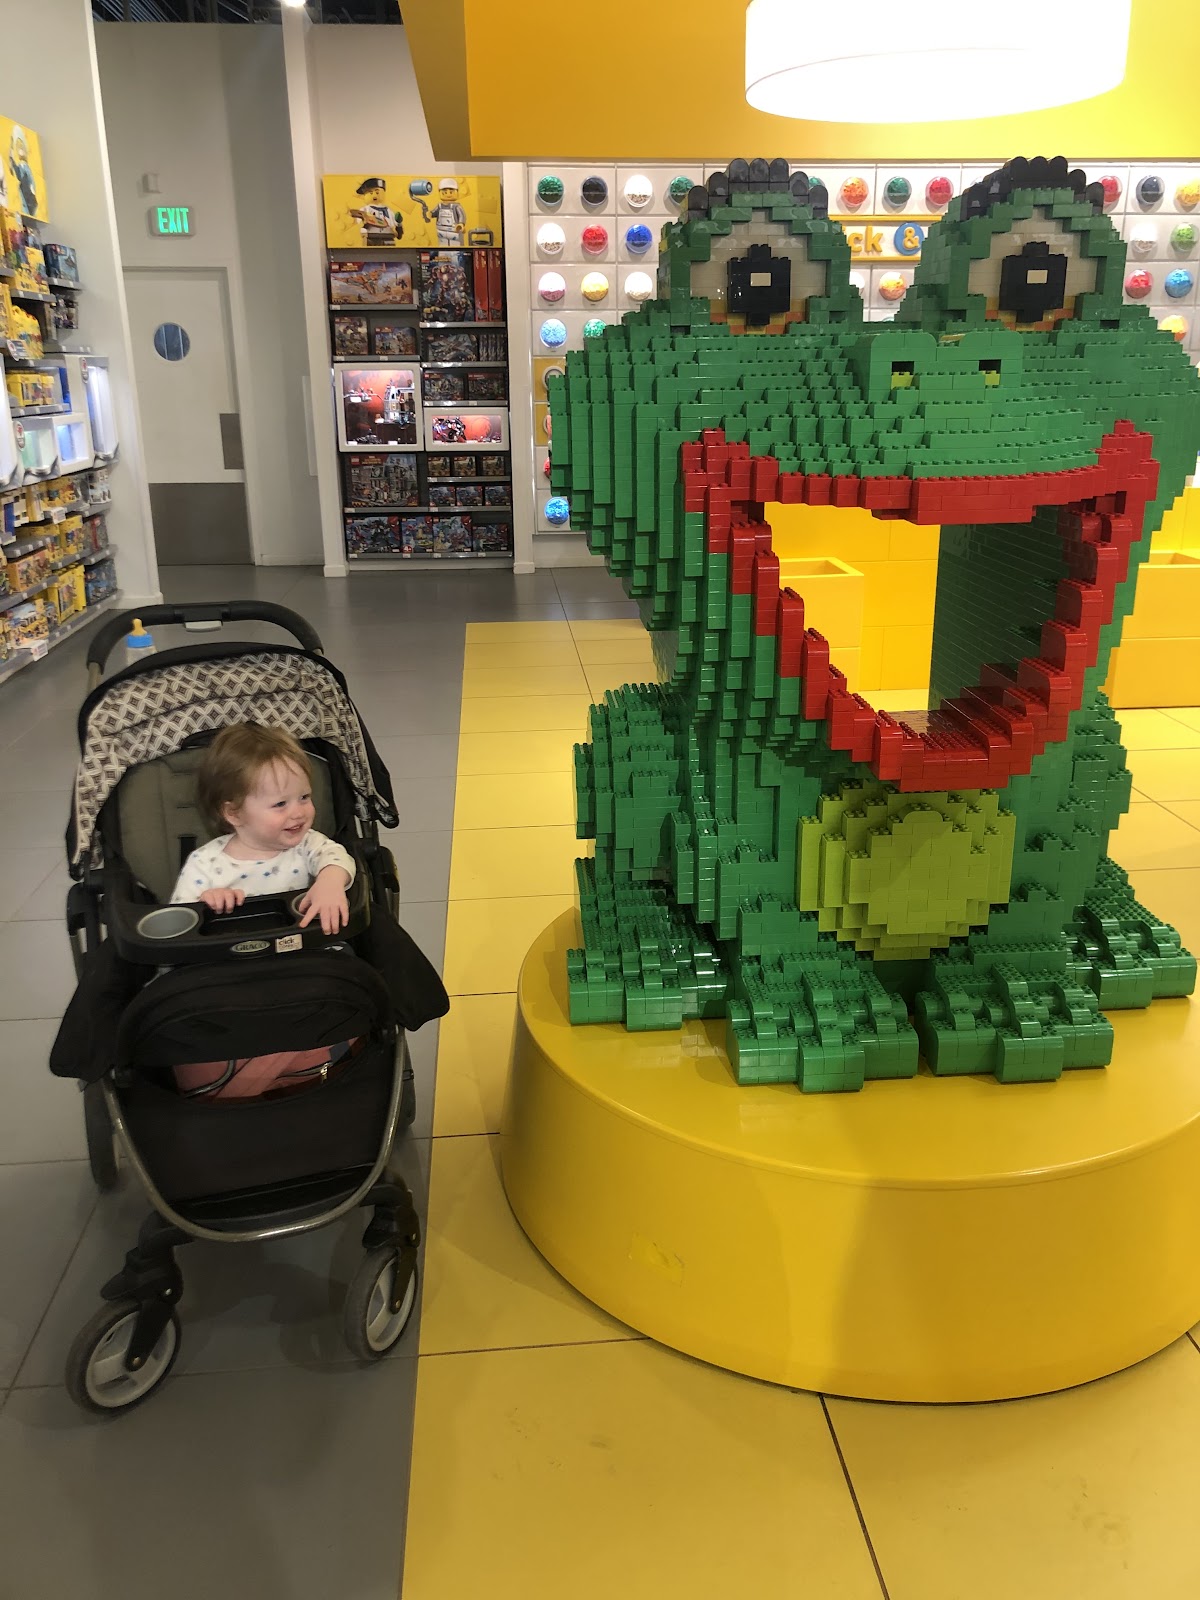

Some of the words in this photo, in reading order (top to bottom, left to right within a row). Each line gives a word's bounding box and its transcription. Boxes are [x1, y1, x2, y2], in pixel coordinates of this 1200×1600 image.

[157, 207, 189, 233] EXIT
[842, 223, 884, 253] ck
[903, 226, 920, 250] &
[235, 941, 268, 952] GRACO
